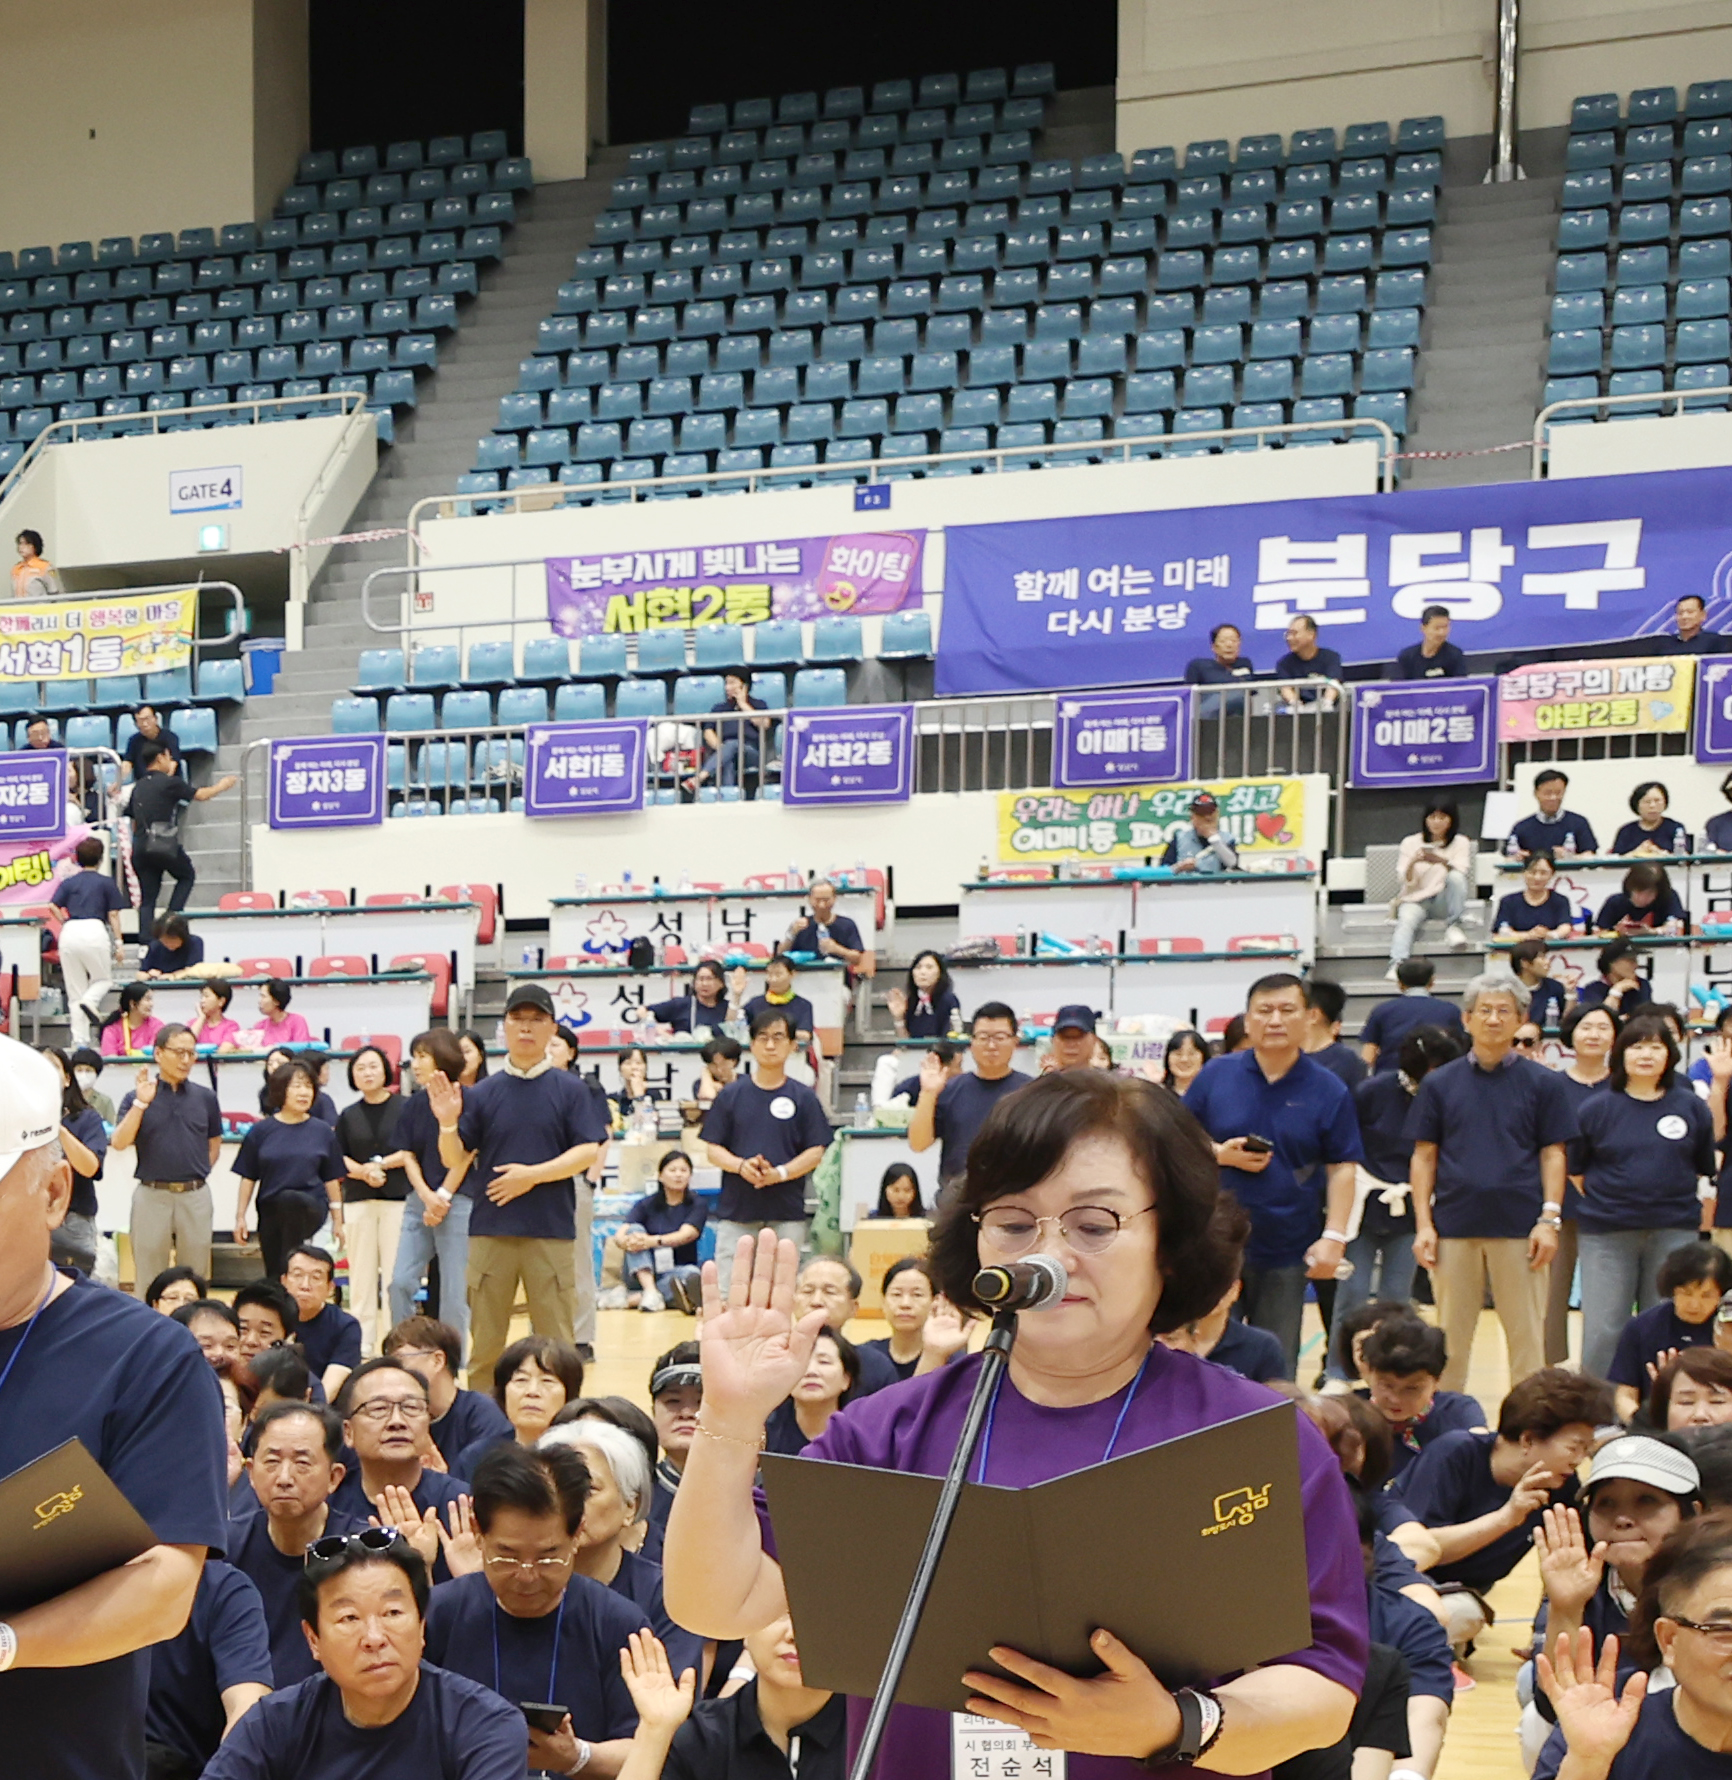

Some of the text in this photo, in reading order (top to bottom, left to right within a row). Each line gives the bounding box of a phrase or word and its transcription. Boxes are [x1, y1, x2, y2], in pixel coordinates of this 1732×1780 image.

[570, 542, 802, 590] 눈부시게 빛나는
[826, 547, 912, 583] 화이팅
[1013, 555, 1231, 601] 함께 여는 미래
[1251, 517, 1647, 631] 분당구
[602, 583, 773, 634] 서현2동
[1046, 603, 1190, 637] 다시 분당
[1617, 664, 1676, 693] 자랑
[1374, 715, 1475, 747] 이매2동
[1535, 698, 1639, 732] 야탑2동
[802, 740, 894, 768] 서현2동
[1076, 725, 1168, 756] 이매1동
[285, 767, 368, 796] 정자3동
[543, 752, 626, 780] 서현1동
[1086, 793, 1141, 820] 하나
[1224, 783, 1283, 812] 최고
[981, 1740, 1017, 1752] 협의회
